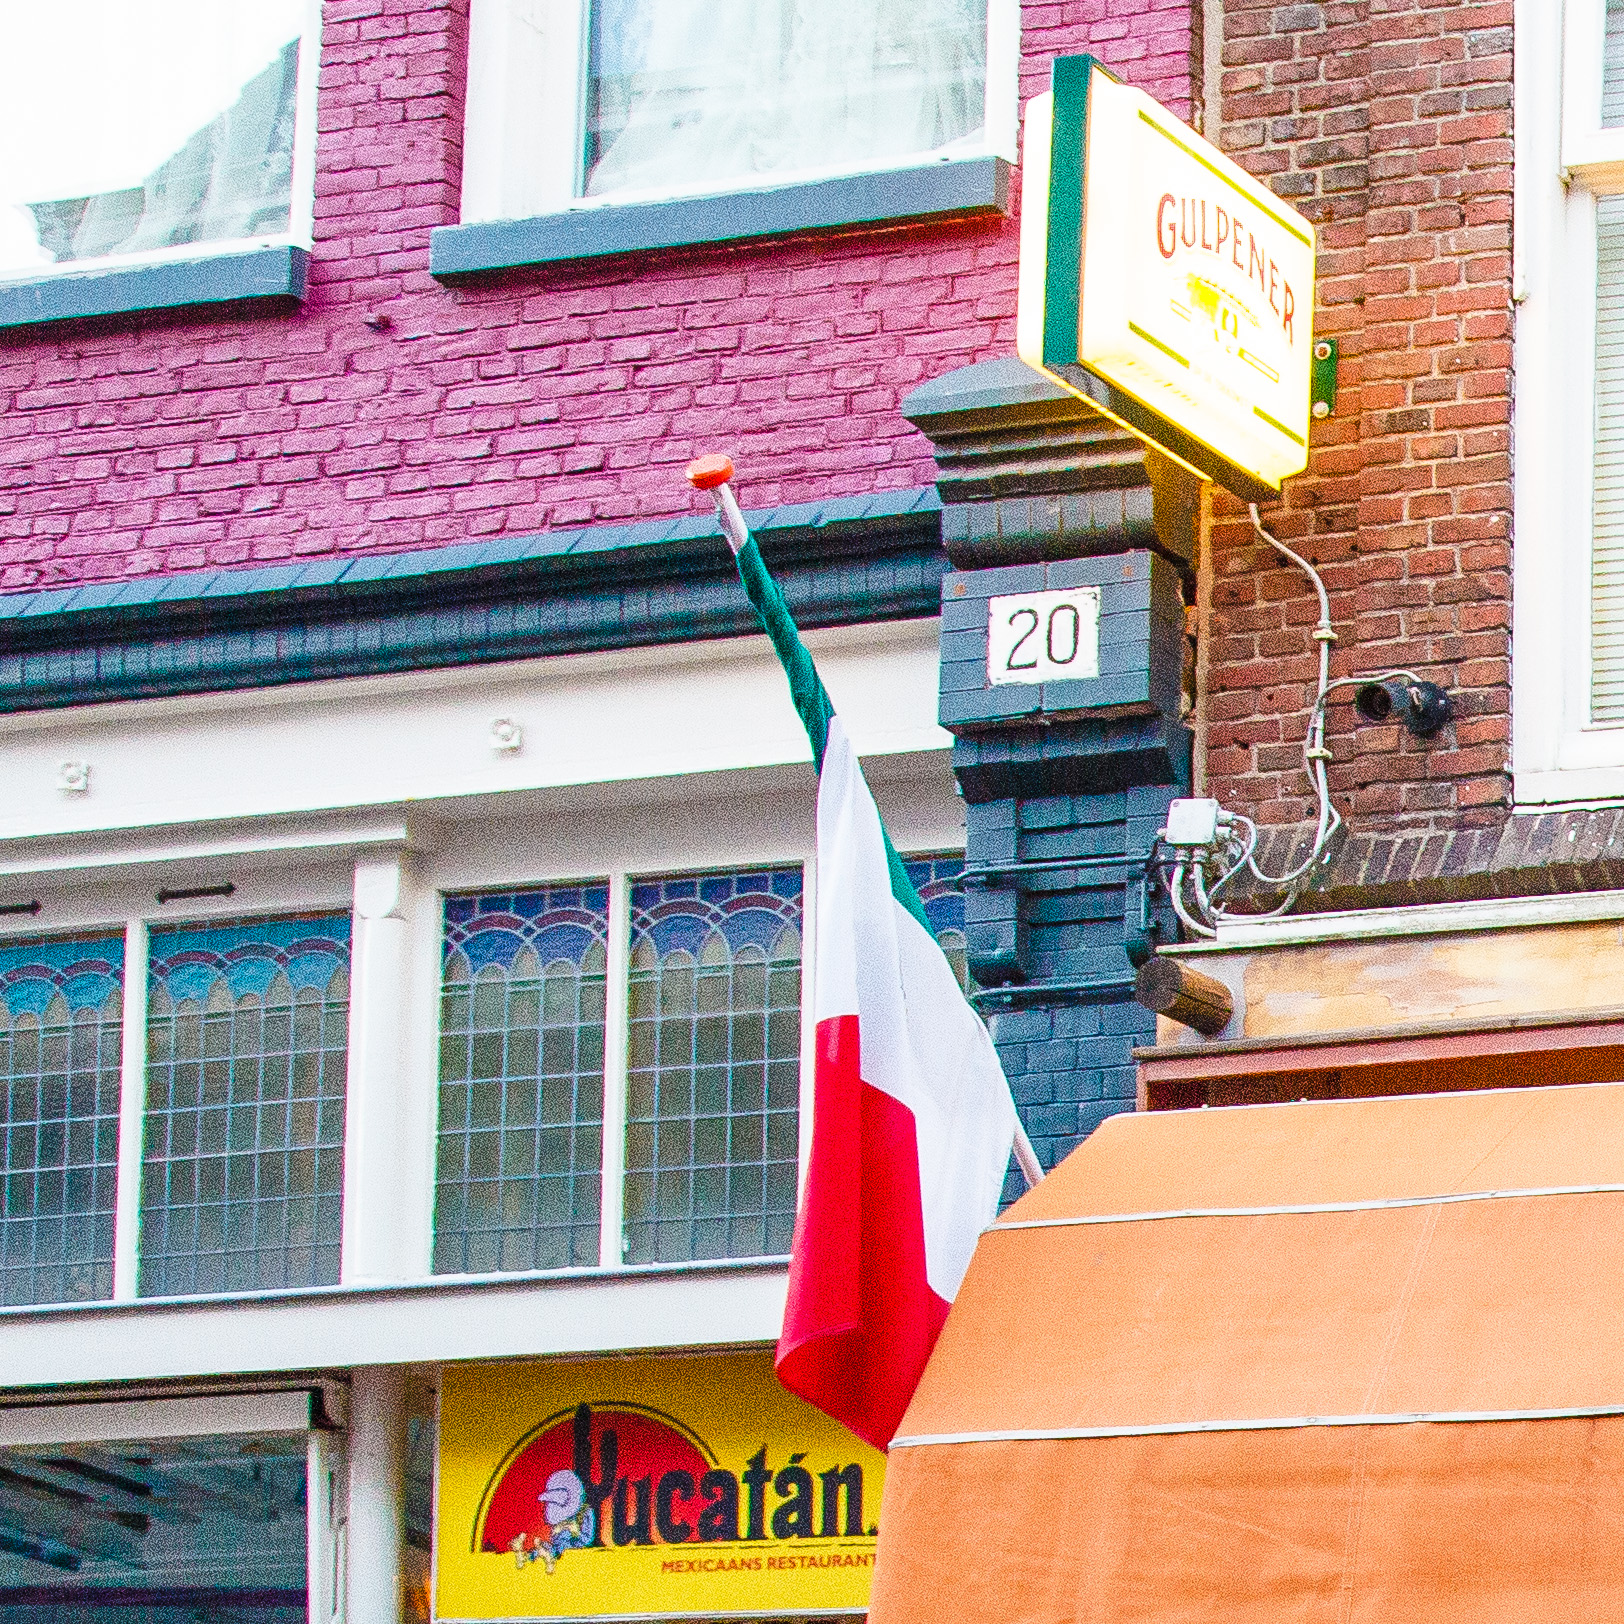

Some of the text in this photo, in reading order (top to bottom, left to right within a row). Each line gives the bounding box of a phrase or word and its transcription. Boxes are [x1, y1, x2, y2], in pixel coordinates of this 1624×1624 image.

[1156, 192, 1295, 347] GULPENER
[1007, 602, 1080, 671] 20
[574, 1403, 865, 1548] Yucatán
[661, 1557, 762, 1573] MEXICAANS
